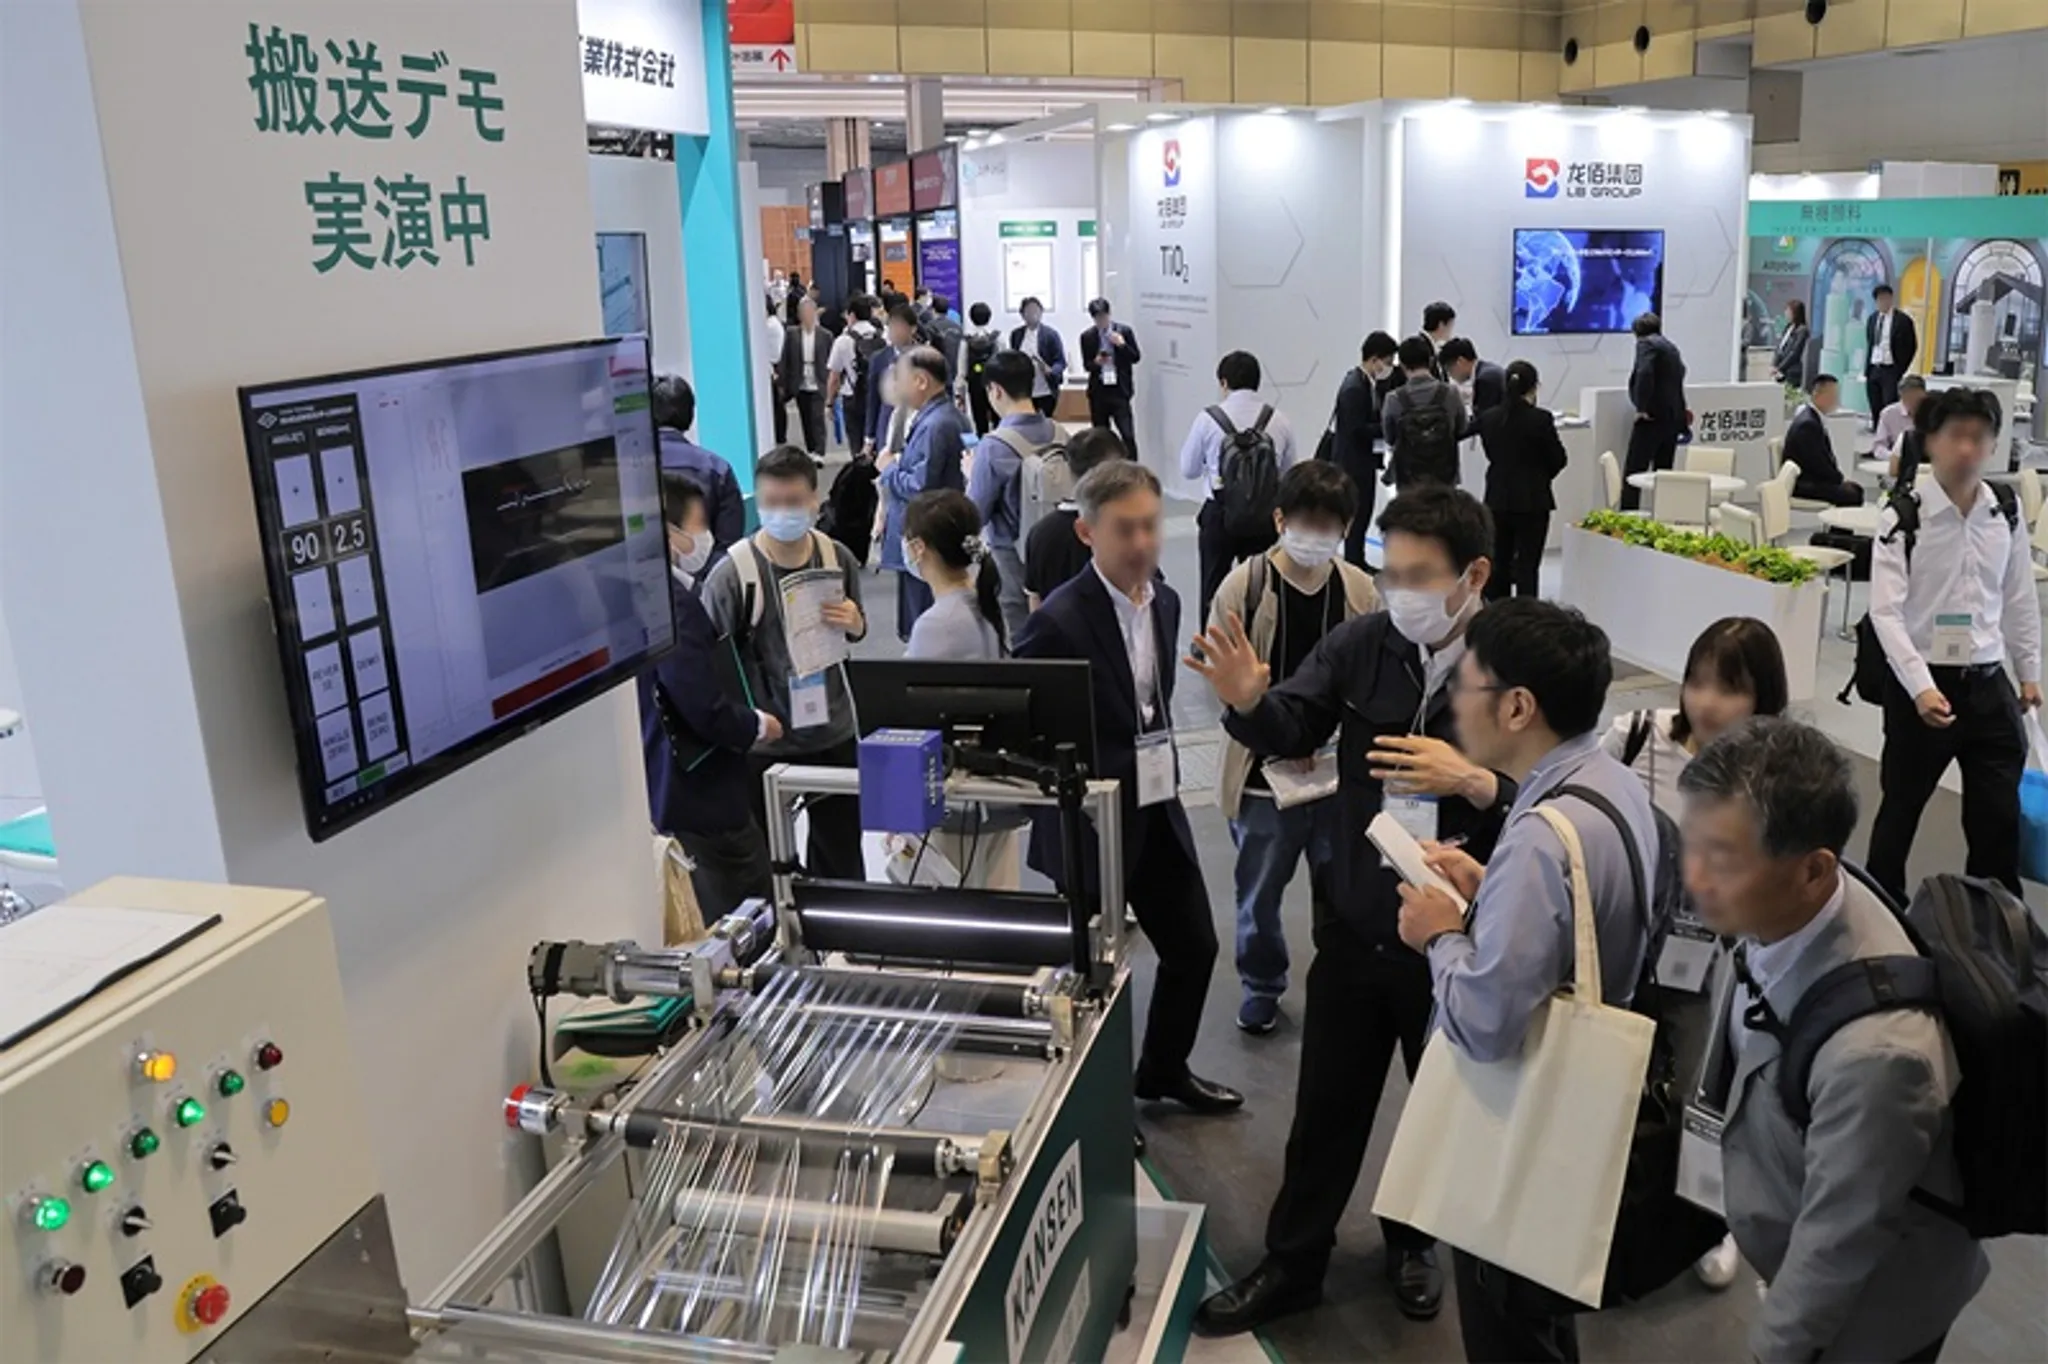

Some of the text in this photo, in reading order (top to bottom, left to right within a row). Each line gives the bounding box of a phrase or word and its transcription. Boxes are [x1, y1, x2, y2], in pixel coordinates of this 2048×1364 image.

[245, 23, 506, 142] 搬送デモ
[578, 33, 676, 89] 業株式会社
[1566, 186, 1643, 198] LB GROUP
[1567, 162, 1643, 185] 龙佰集团
[304, 171, 491, 273] 実演中
[292, 532, 319, 564] 90
[334, 519, 365, 554] 2.5
[1012, 1164, 1077, 1345] KANSEN
